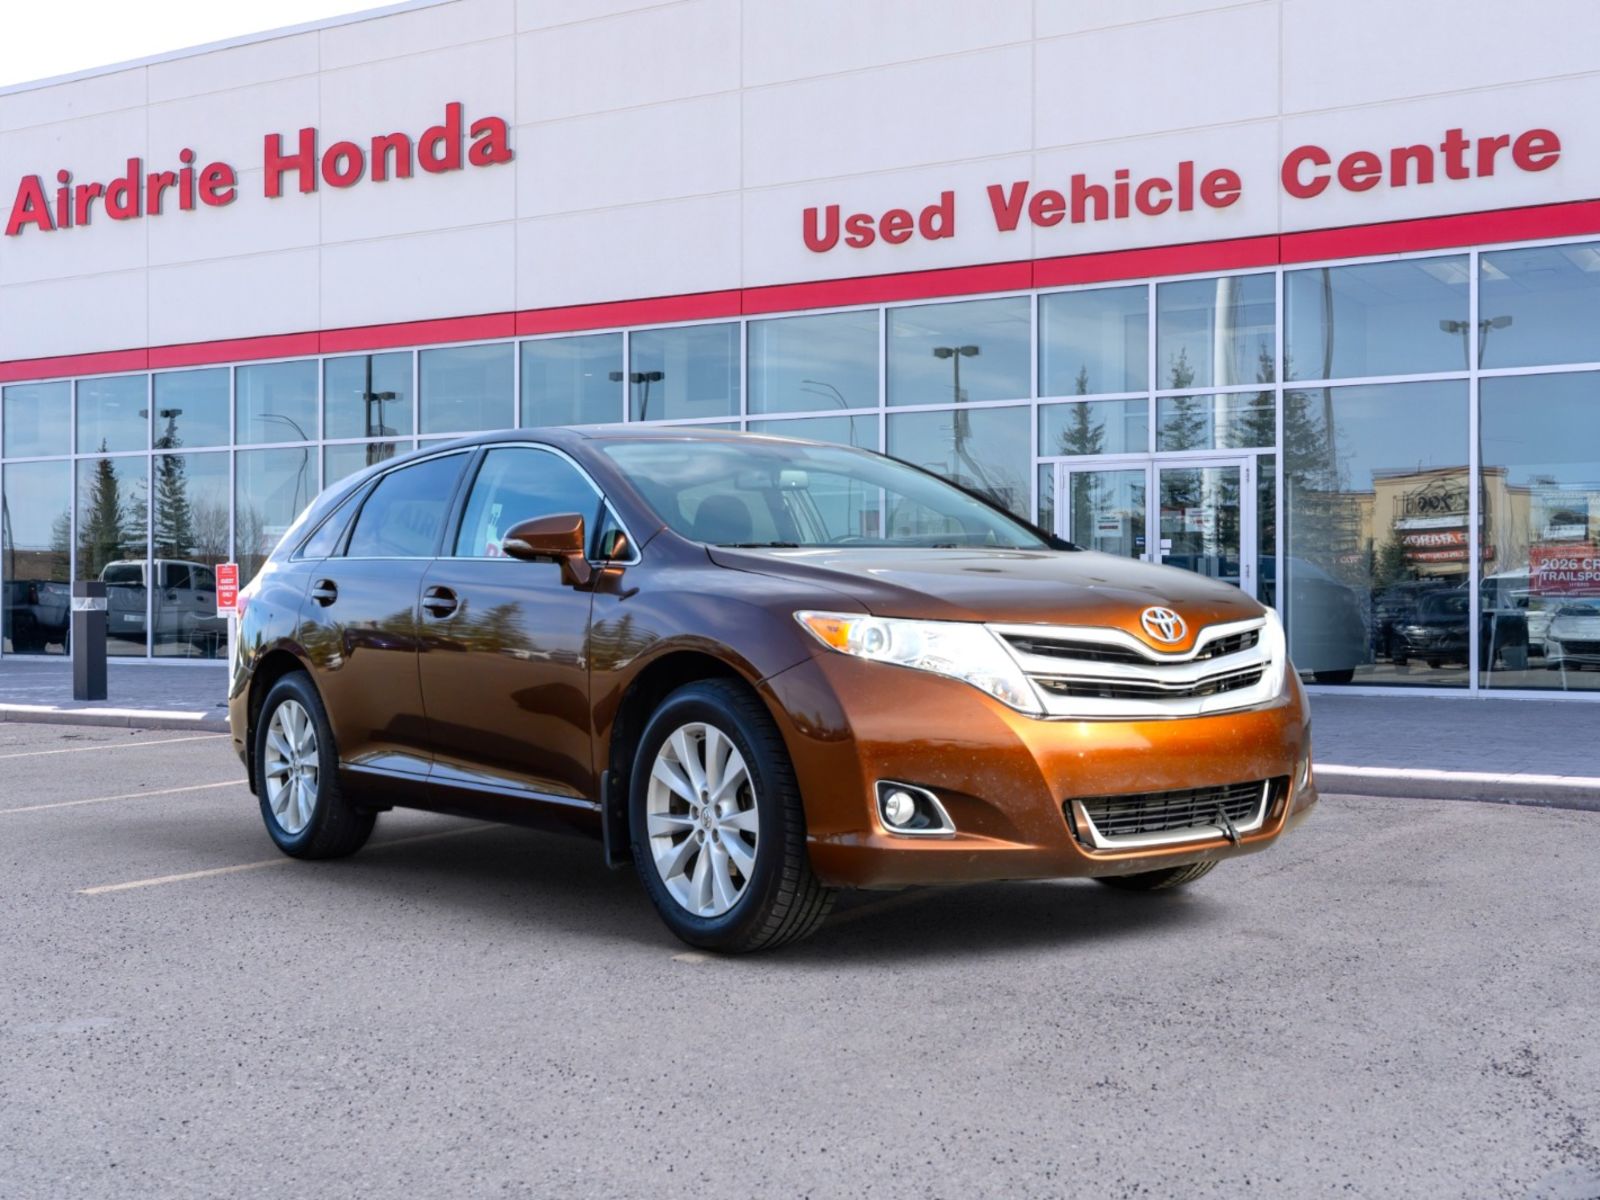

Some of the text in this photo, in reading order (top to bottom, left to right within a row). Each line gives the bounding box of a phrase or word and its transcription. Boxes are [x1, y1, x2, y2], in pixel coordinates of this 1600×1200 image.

[4, 101, 513, 236] Airdrie Honda
[803, 128, 1561, 253] Used Vehicle Centre
[1541, 558, 1578, 570] 2026
